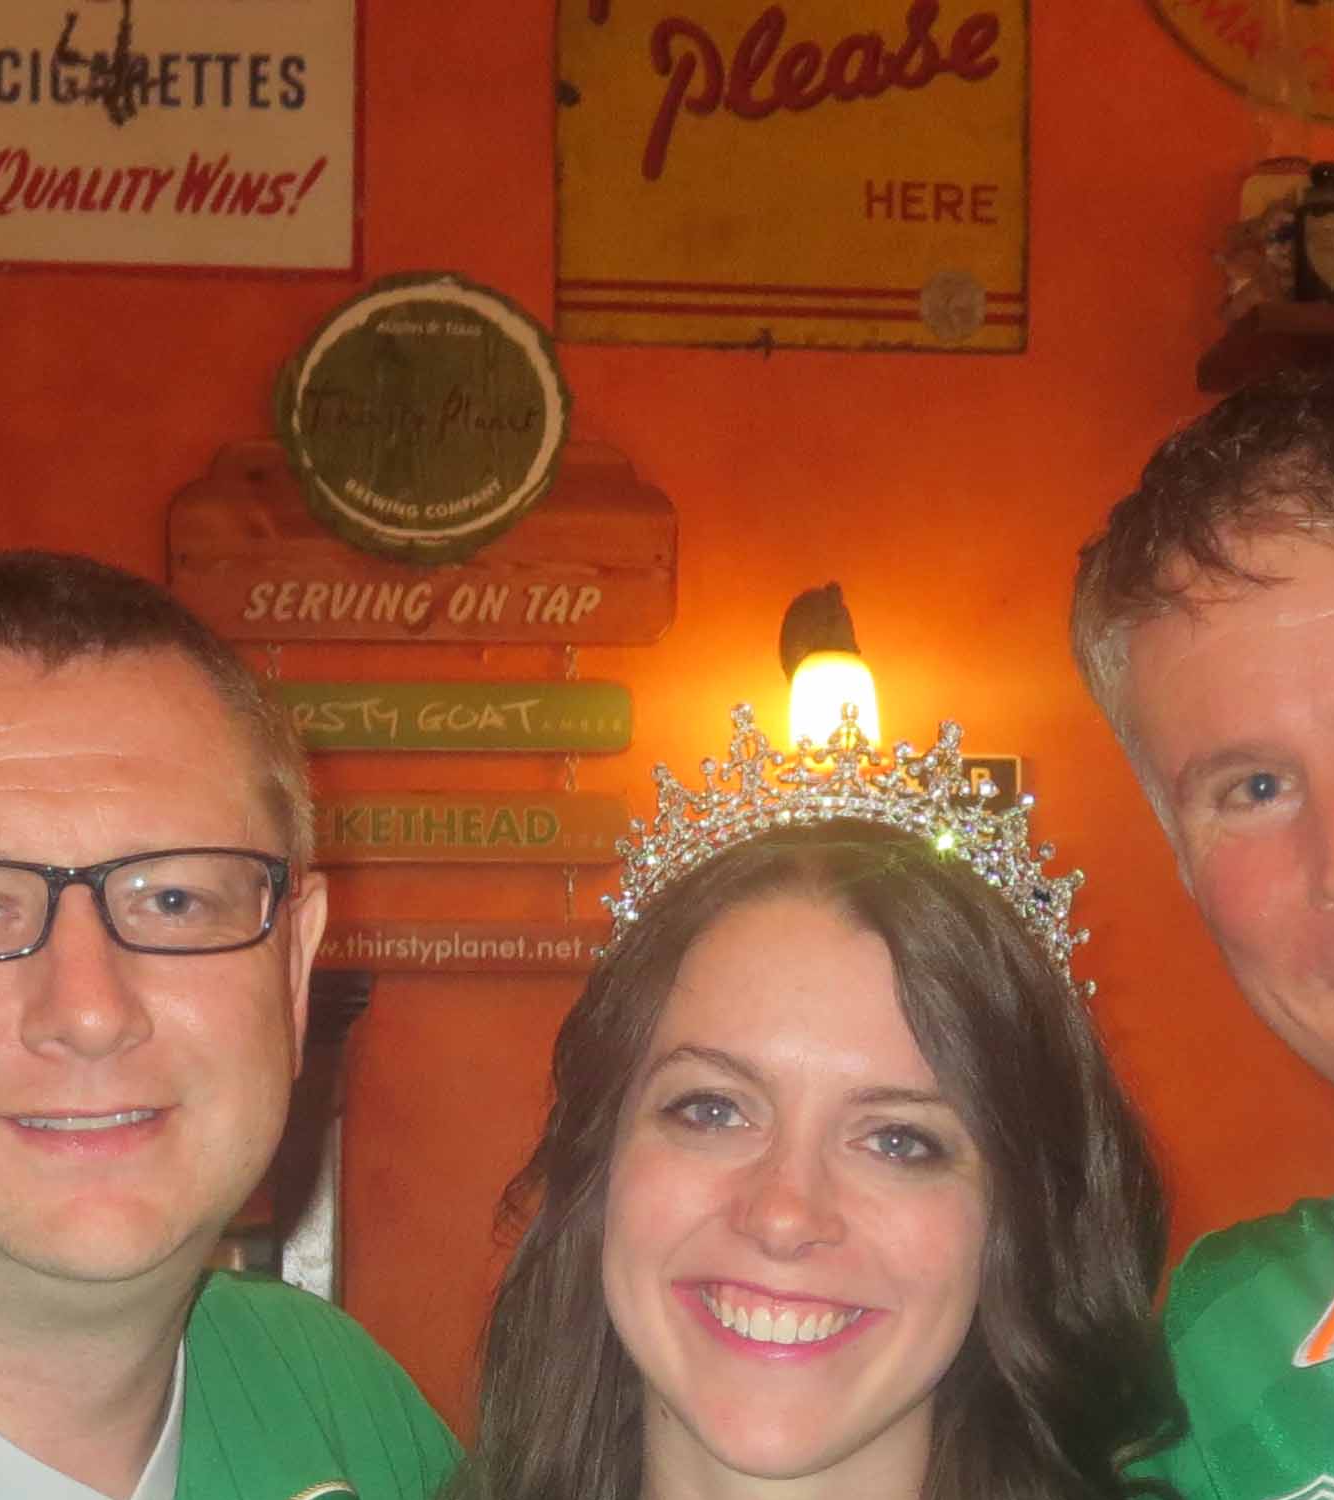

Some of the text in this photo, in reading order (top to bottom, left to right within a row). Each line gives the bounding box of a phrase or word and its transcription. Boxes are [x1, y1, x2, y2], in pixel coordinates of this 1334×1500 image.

[865, 180, 1000, 225] HERE
[344, 475, 503, 519] BREWING COMPANY
[243, 582, 603, 626] SERVING ON TAP
[416, 699, 541, 735] GOAT
